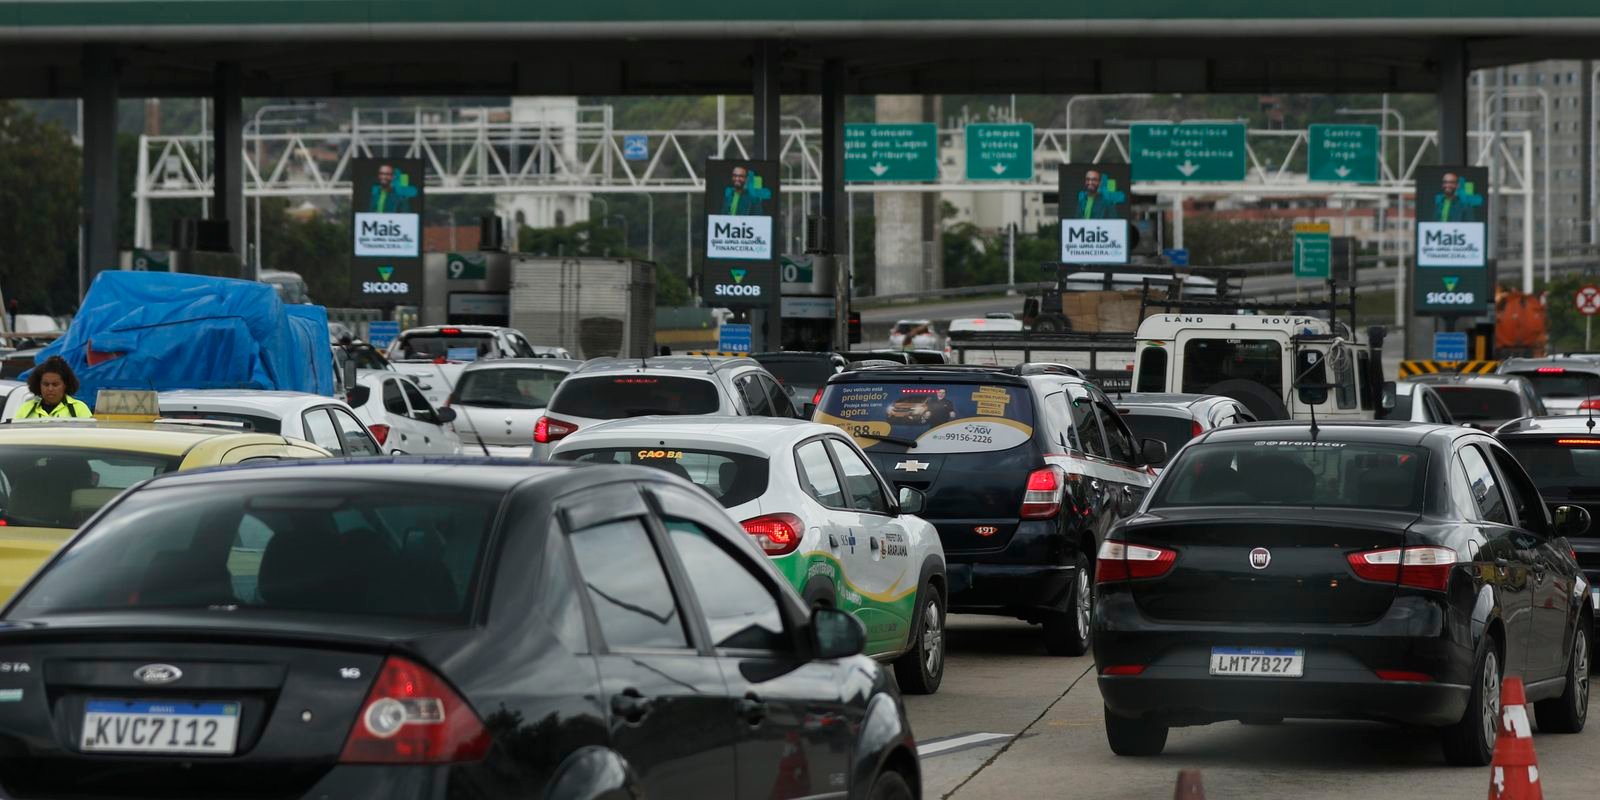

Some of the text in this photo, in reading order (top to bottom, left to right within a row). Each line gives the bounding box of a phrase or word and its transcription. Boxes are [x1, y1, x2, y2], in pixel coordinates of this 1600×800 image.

[362, 220, 402, 237] Mais
[714, 222, 754, 239] Mais
[1068, 226, 1109, 243] Mais
[1425, 229, 1466, 246] Mais
[450, 260, 465, 278] 9
[362, 282, 409, 294] SICOOB
[715, 284, 761, 296] SICOOB
[1426, 292, 1475, 304] SICOOB
[1165, 316, 1204, 324] LAND
[100, 391, 156, 414] TAXI
[841, 393, 889, 403] protegido?
[840, 409, 869, 418] agora.
[1253, 553, 1267, 564] FIAT
[1218, 655, 1294, 673] LMT7B27
[143, 669, 170, 681] Ford
[94, 717, 219, 747] KVC7I12
